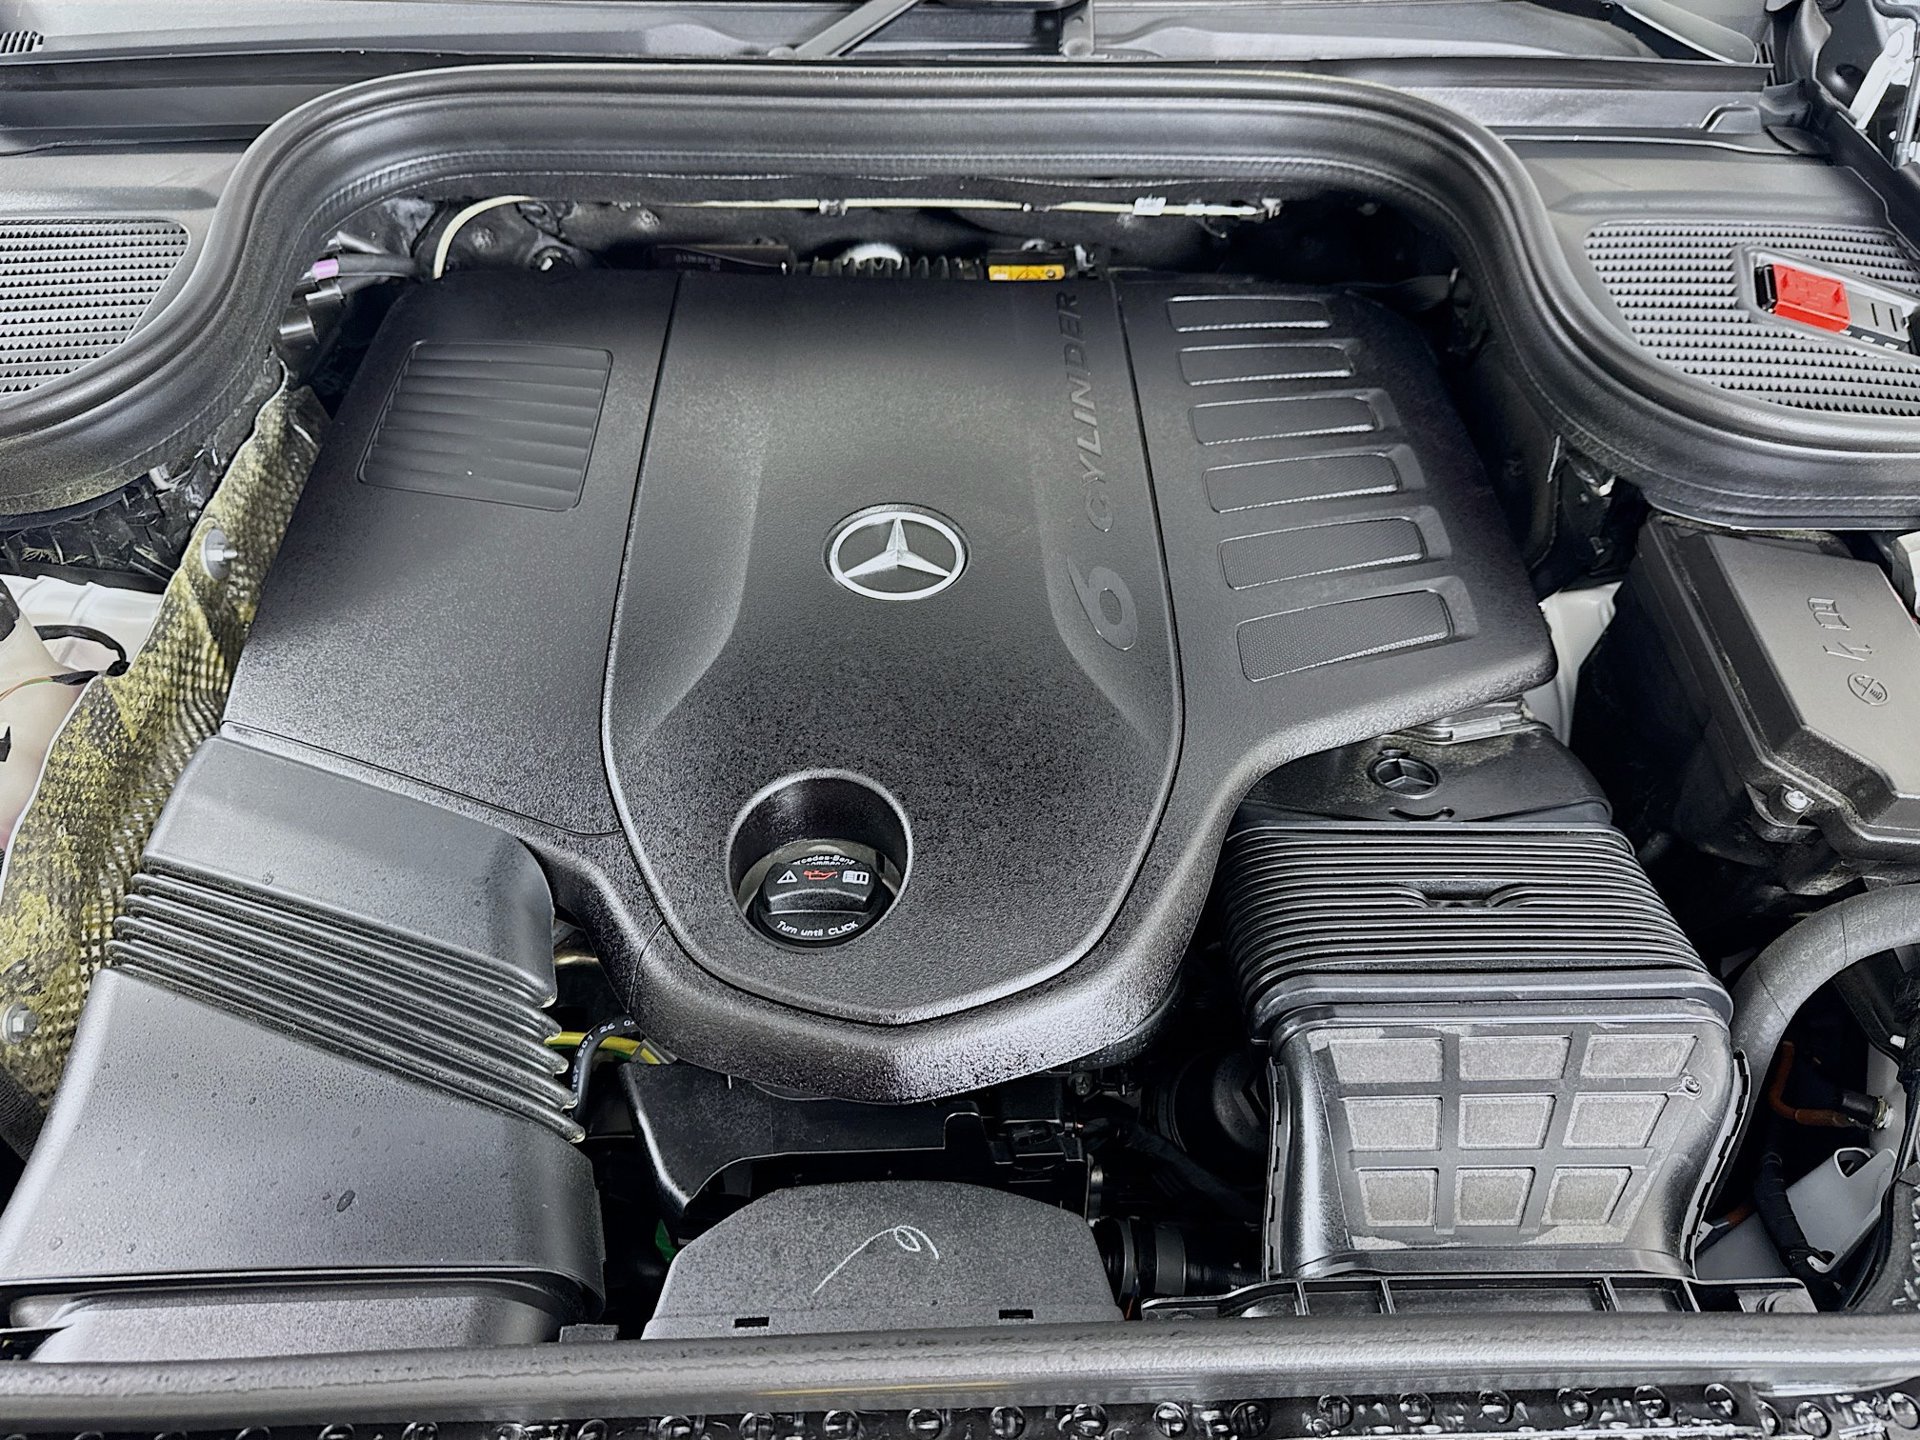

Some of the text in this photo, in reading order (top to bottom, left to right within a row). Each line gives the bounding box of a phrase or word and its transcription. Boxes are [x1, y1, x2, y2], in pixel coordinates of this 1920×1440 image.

[1056, 290, 1139, 651] 6 CYLINDER
[792, 854, 856, 865] rcedes-Benz
[777, 920, 859, 937] Turn until CLICK
